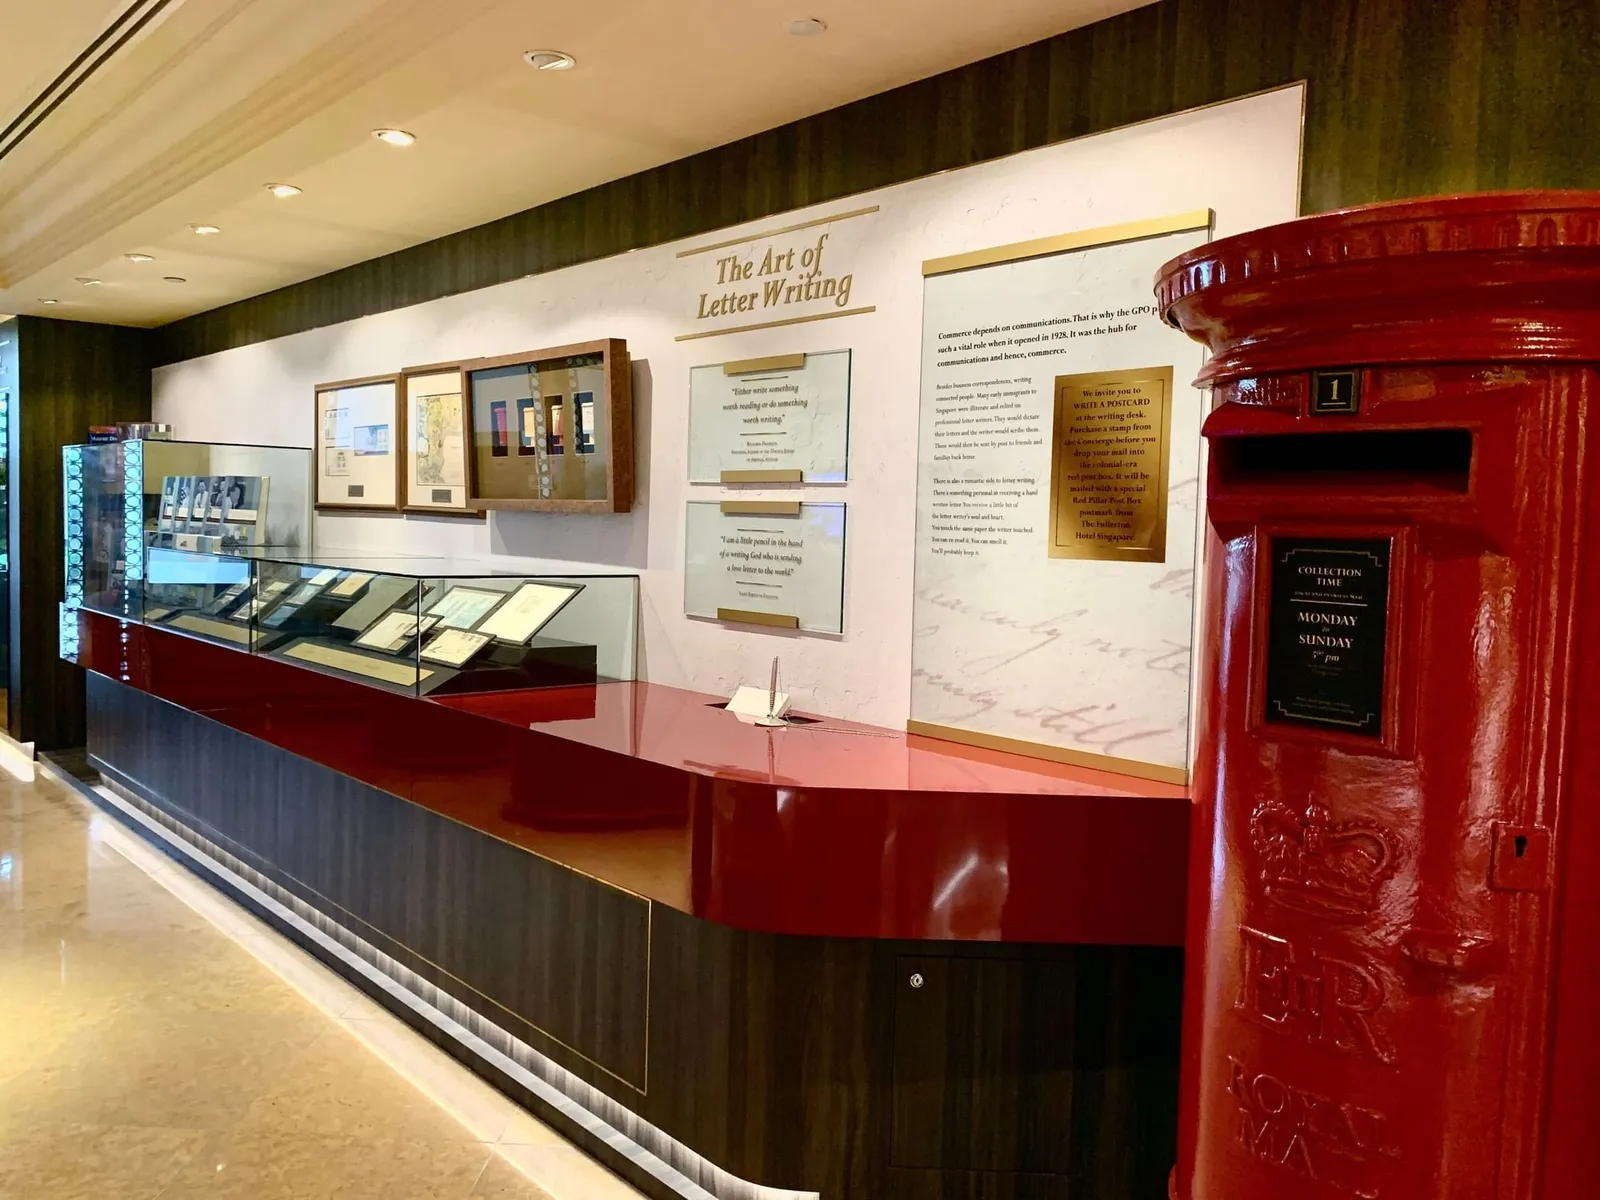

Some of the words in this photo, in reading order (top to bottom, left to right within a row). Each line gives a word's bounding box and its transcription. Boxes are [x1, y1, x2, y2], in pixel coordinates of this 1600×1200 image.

[716, 255, 753, 284] The
[757, 248, 795, 276] Art
[800, 233, 829, 278] of
[697, 292, 758, 319] Letter
[764, 272, 853, 308] Writing
[938, 331, 972, 340] Commerce
[973, 325, 1000, 337] depends
[1012, 317, 1072, 330] communications.
[1072, 314, 1089, 322] That
[1092, 312, 1097, 320] is
[1099, 310, 1114, 320] why
[1117, 309, 1130, 317] the
[1132, 306, 1150, 315] GPO
[973, 341, 986, 349] role
[1014, 334, 1040, 346] opened
[1051, 331, 1068, 340] 1928.
[1070, 330, 1076, 338] It
[1077, 329, 1092, 337] was
[1093, 327, 1106, 335] the
[1108, 325, 1123, 333] hub
[1125, 323, 1137, 331] for
[937, 356, 989, 367] communications
[990, 353, 1002, 361] and
[1004, 352, 1026, 360] hence,
[1028, 348, 1066, 357] commerce.
[1329, 379, 1339, 401] 1
[1107, 398, 1150, 407] POSTCARD
[1097, 412, 1124, 421] writing
[1126, 410, 1146, 419] desk.
[1070, 425, 1102, 433] Purchase
[1108, 425, 1131, 433] stamp
[1073, 450, 1091, 459] drop
[1111, 448, 1127, 456] mail
[1298, 566, 1362, 576] COLLECTION
[1316, 578, 1342, 586] TIME
[1298, 612, 1358, 626] MONDAY
[1299, 634, 1353, 648] SUNDAY
[1325, 654, 1339, 663] pm
